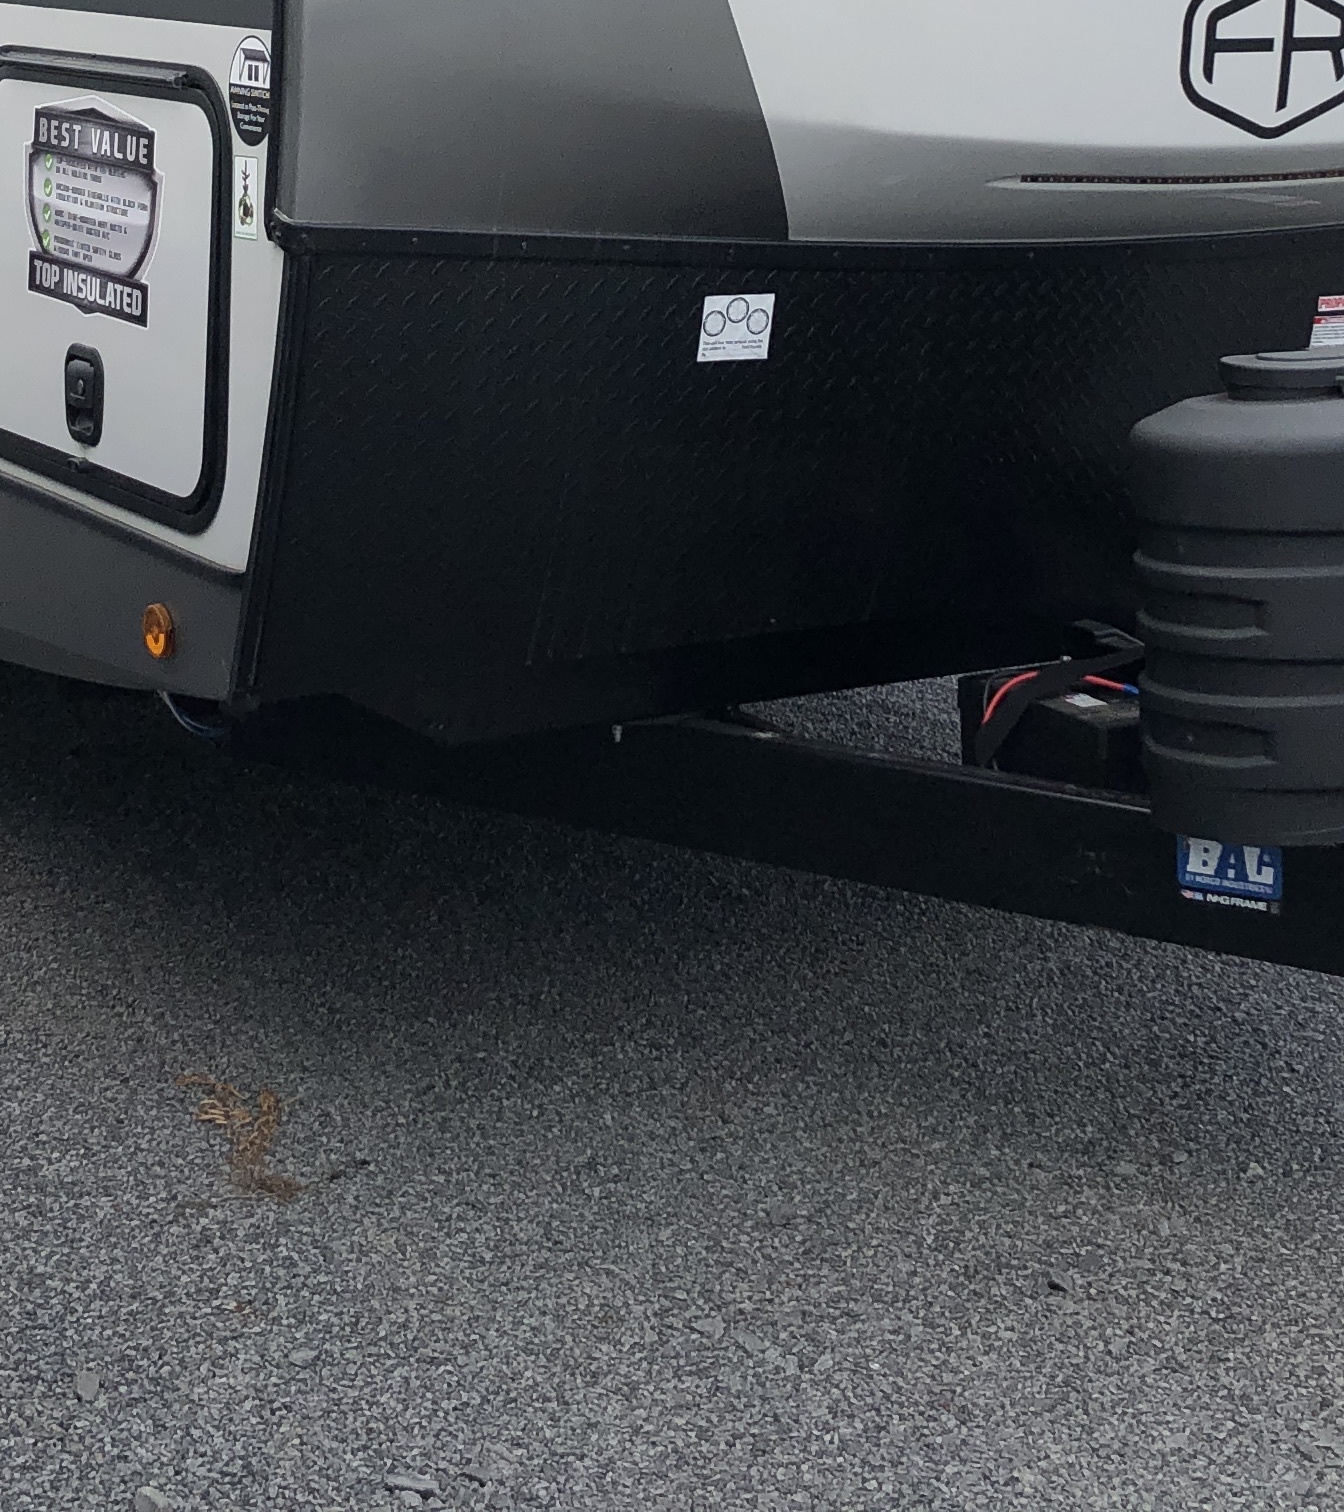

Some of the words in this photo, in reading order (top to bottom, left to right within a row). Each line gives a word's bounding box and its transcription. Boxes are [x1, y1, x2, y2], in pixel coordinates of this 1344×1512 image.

[38, 116, 82, 150] BEST
[91, 127, 149, 165] VALUE
[33, 259, 60, 290] TOP
[63, 268, 143, 316] INSULATED
